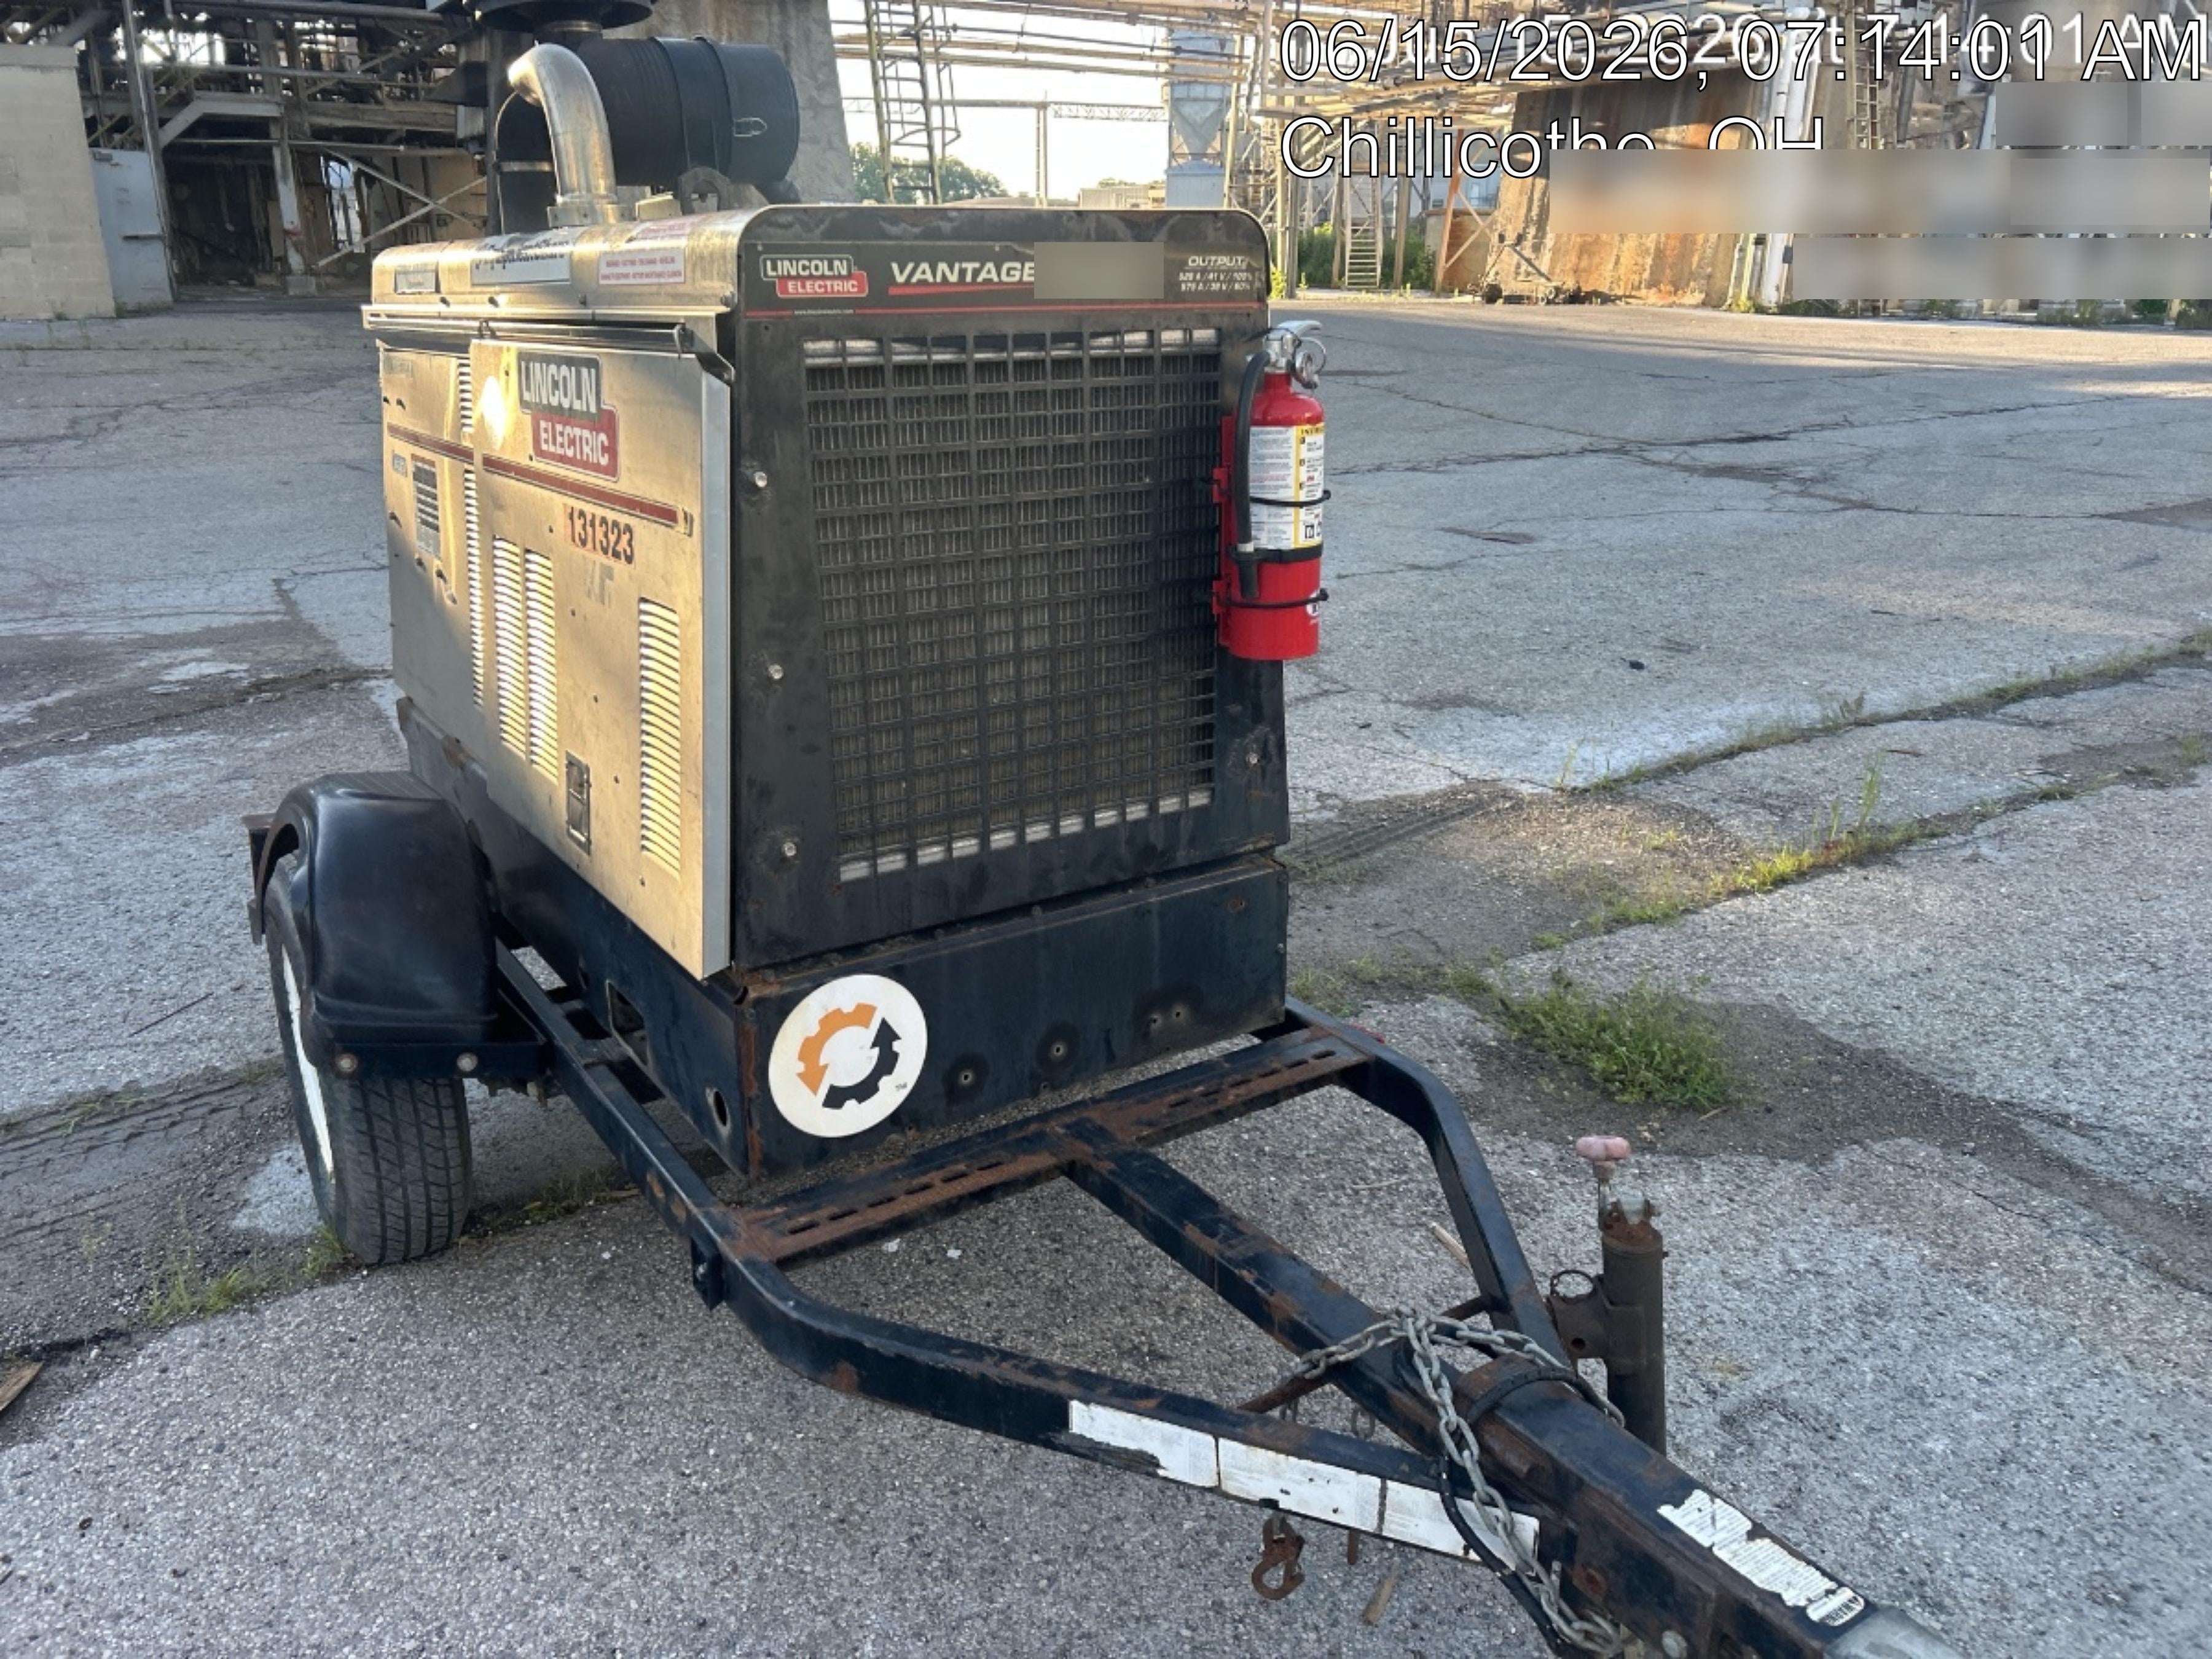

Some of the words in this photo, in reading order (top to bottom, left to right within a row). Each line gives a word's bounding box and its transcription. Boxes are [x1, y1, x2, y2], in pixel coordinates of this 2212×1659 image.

[766, 259, 847, 276] LINCOLN
[1188, 255, 1245, 267] OUTPUT
[787, 280, 858, 294] ELECTRIC
[520, 361, 597, 414] LINCOLN
[539, 420, 610, 466] ELECTRIC
[568, 505, 633, 565] 131323
